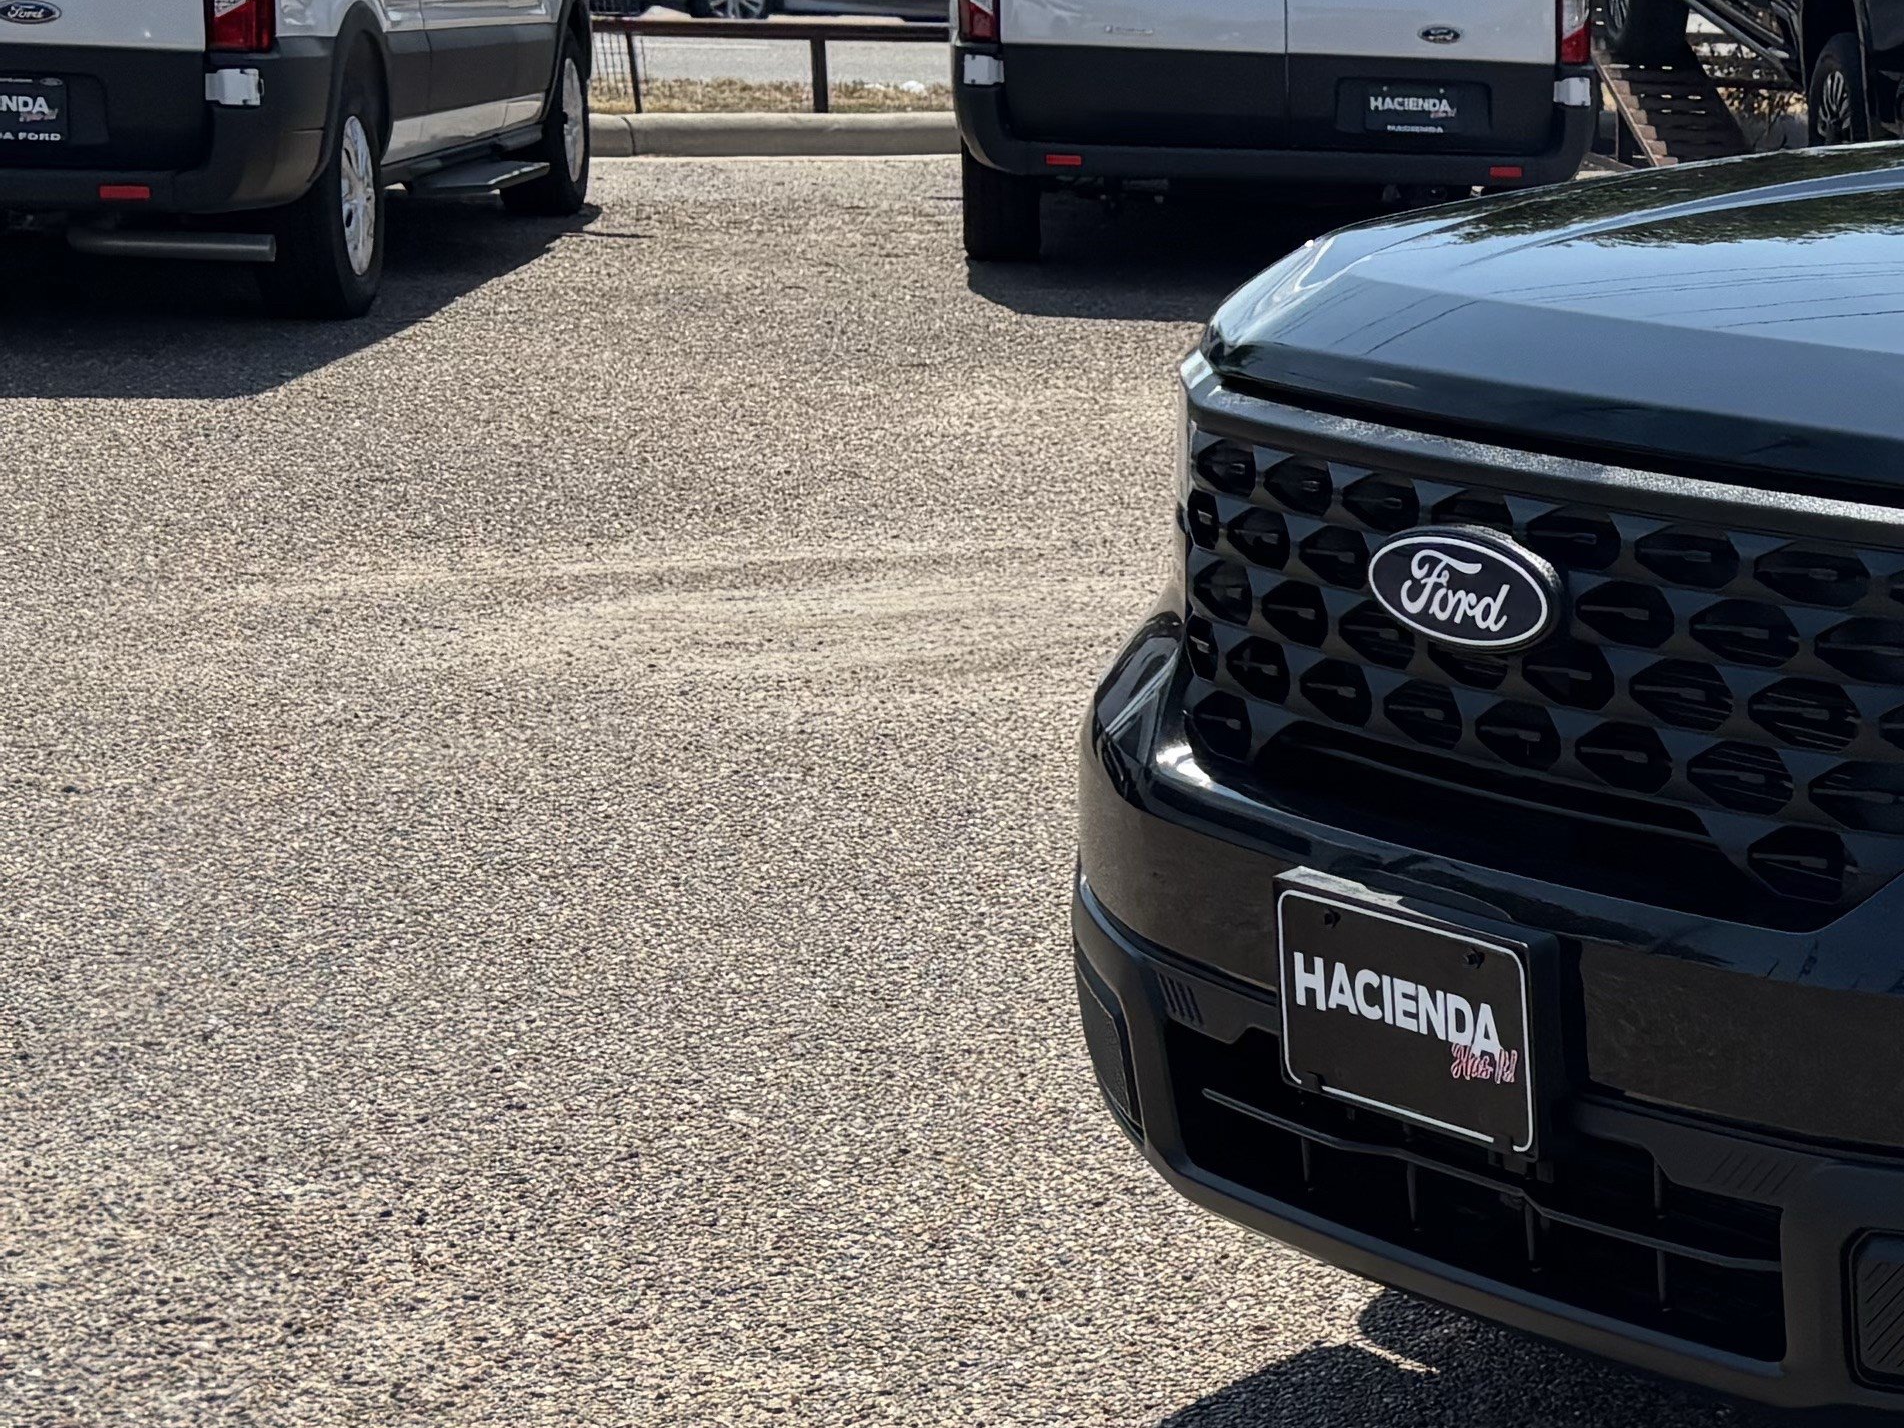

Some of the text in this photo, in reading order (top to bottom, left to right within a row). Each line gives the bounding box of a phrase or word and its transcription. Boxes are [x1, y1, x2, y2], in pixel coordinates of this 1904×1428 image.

[1369, 96, 1452, 115] HACIENDA
[18, 132, 61, 141] FORD
[1400, 549, 1511, 632] Ford
[1293, 951, 1504, 1058] HACIENDA
